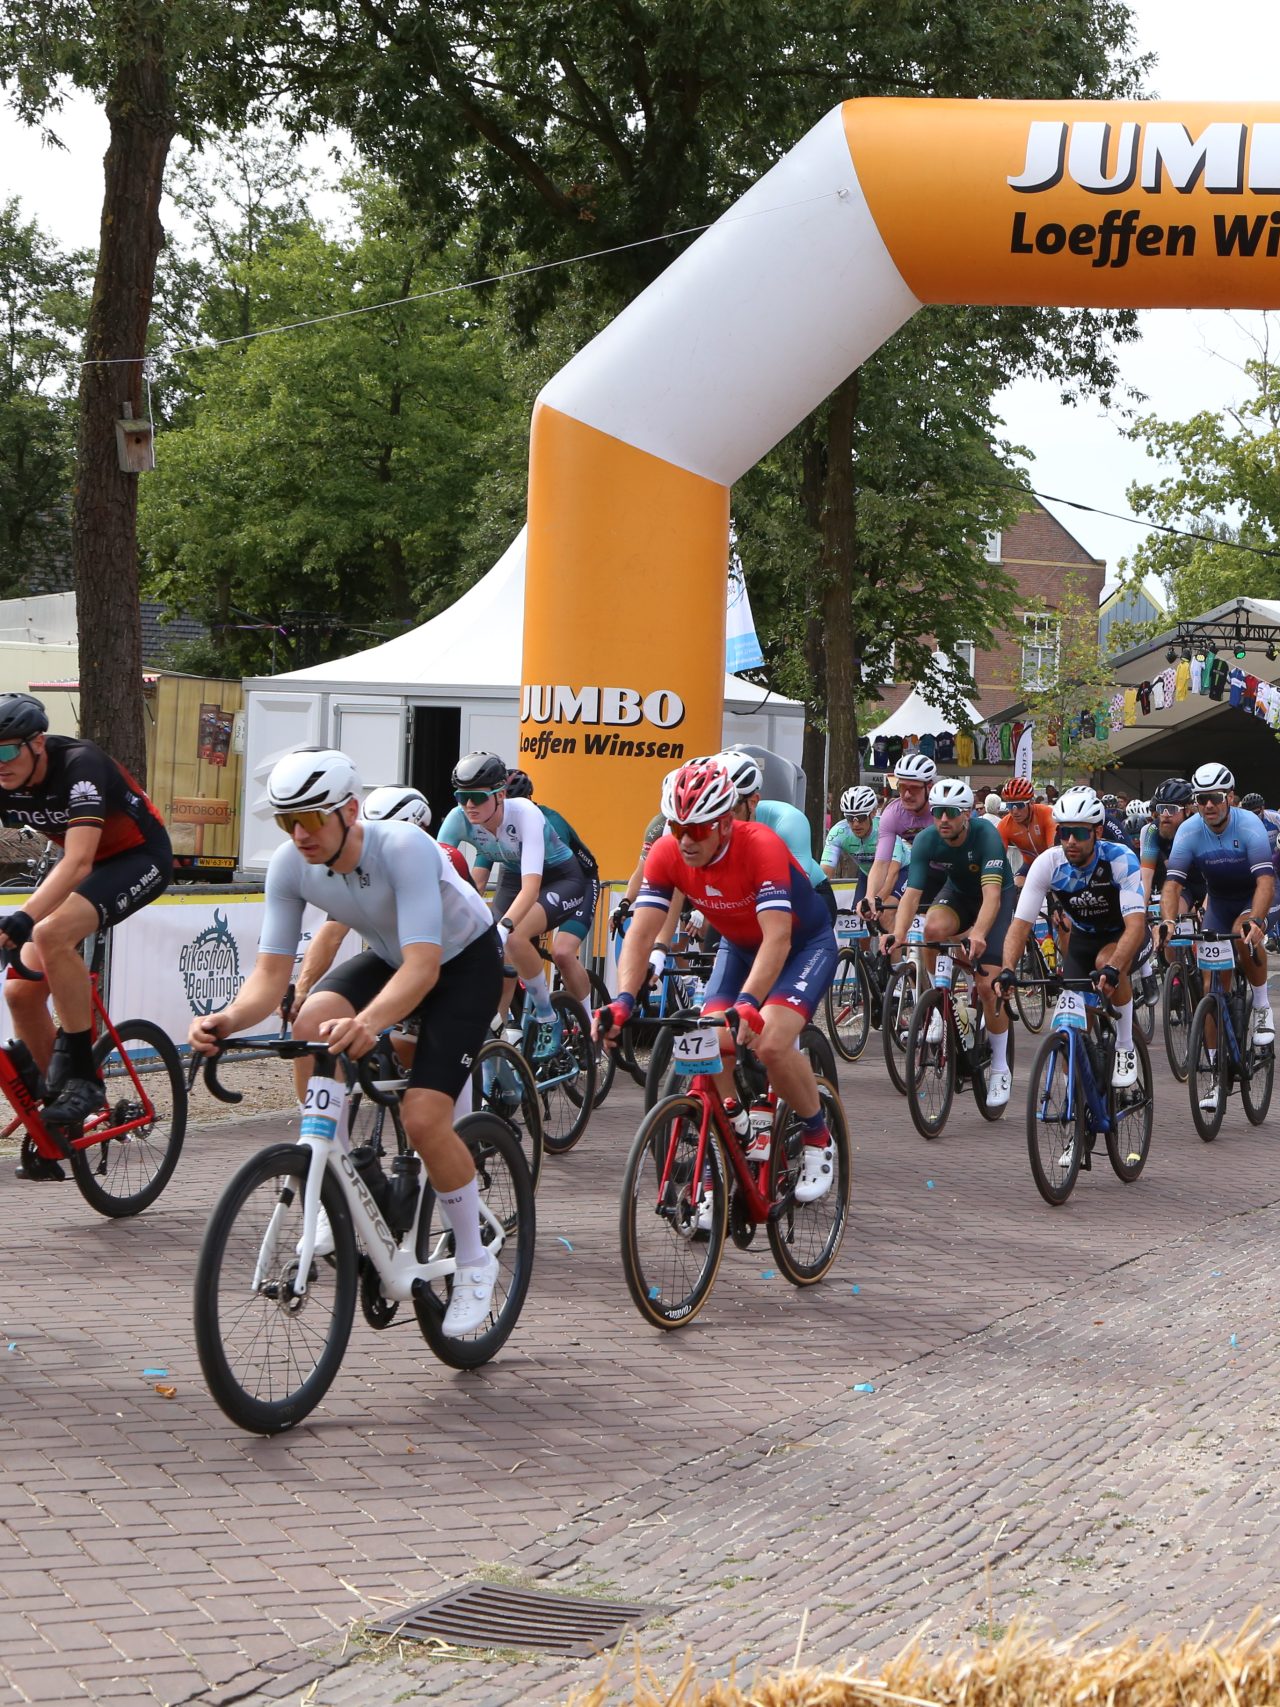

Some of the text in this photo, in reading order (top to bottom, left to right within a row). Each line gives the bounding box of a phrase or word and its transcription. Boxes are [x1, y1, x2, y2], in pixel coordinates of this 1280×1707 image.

[1010, 209, 1197, 268] Loeffen
[520, 684, 686, 730] JUMBO
[519, 730, 684, 760] Loeffen Winssen
[165, 804, 236, 817] PHOTOBOOTH
[844, 919, 857, 928] 25
[179, 942, 233, 976] Bikeshop
[1205, 946, 1220, 958] 29
[937, 961, 945, 972] 5
[1059, 996, 1076, 1010] 35
[678, 1037, 703, 1055] 47
[303, 1088, 330, 1110] 20
[340, 1153, 400, 1262] ORBEA
